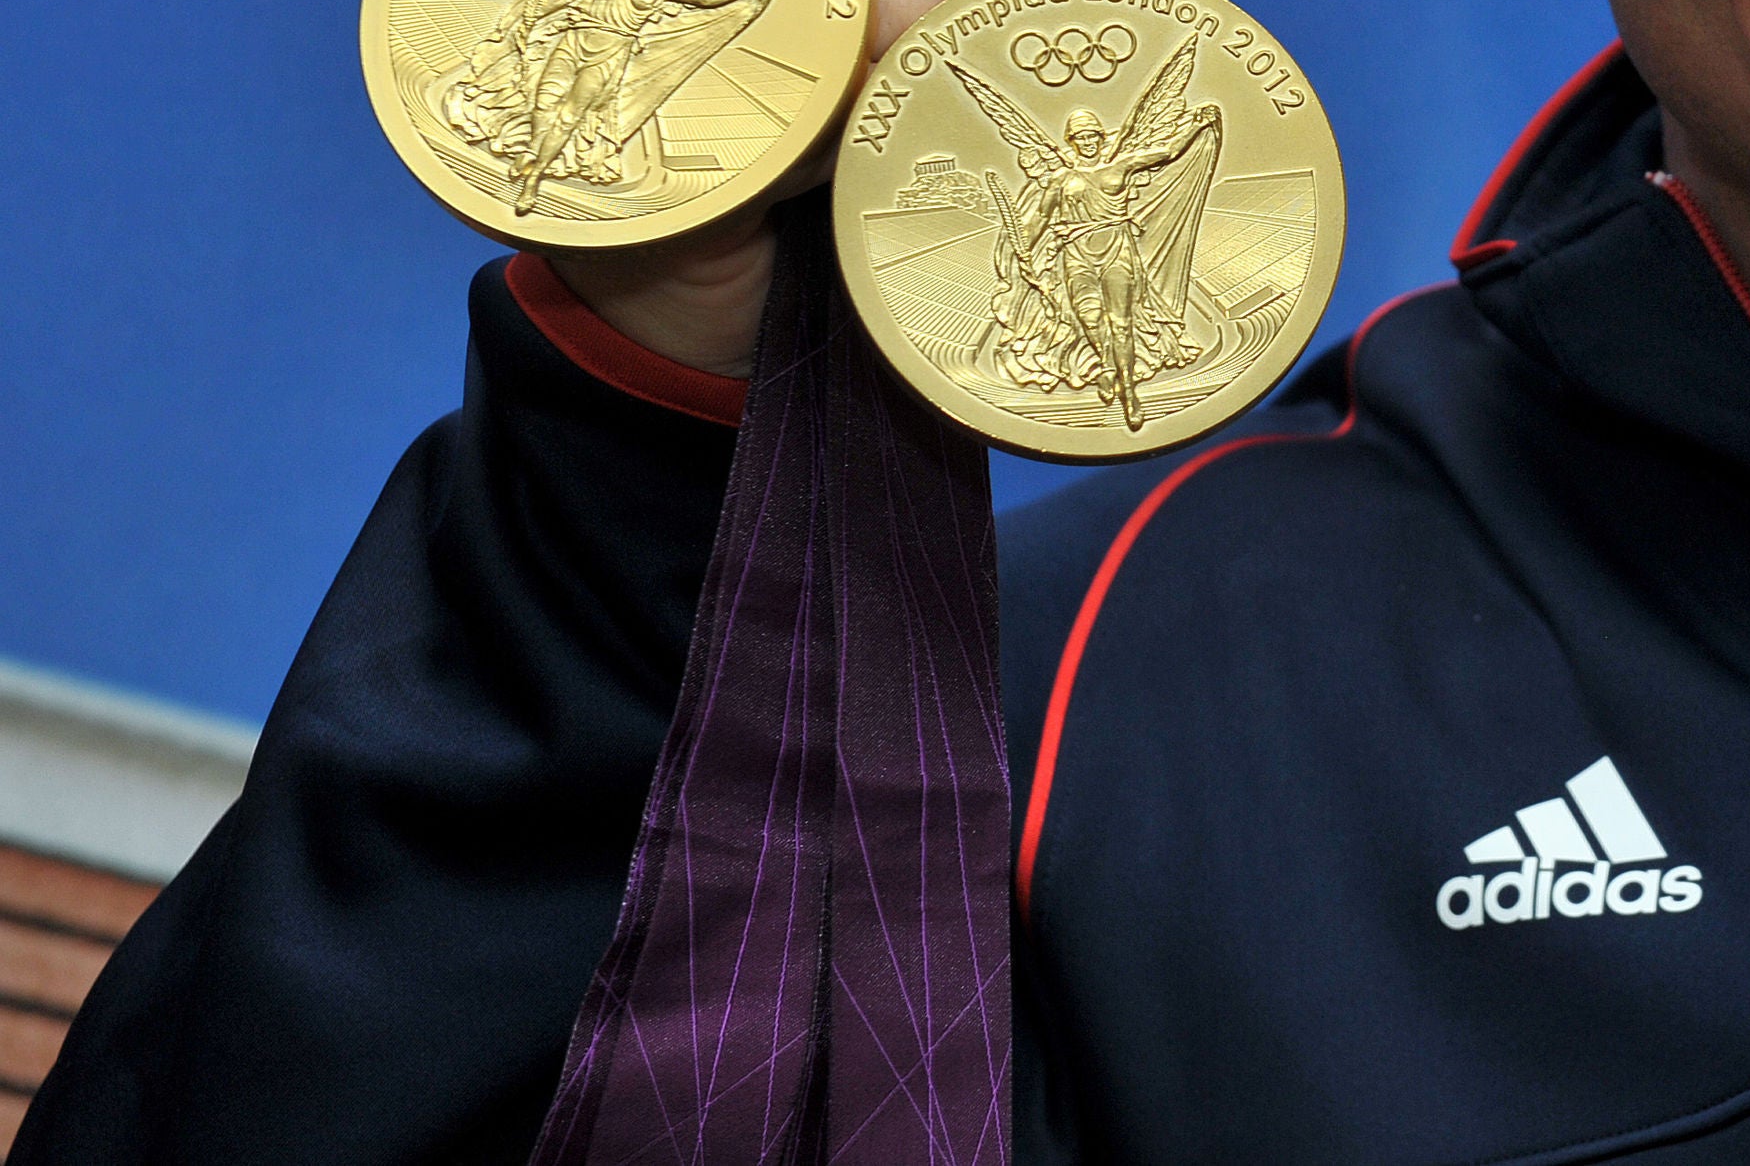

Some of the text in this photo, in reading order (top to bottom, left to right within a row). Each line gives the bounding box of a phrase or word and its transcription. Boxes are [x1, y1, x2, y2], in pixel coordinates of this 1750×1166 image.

[853, 78, 911, 154] XXX
[1223, 28, 1306, 117] 2012
[1436, 856, 1703, 930] adidas
